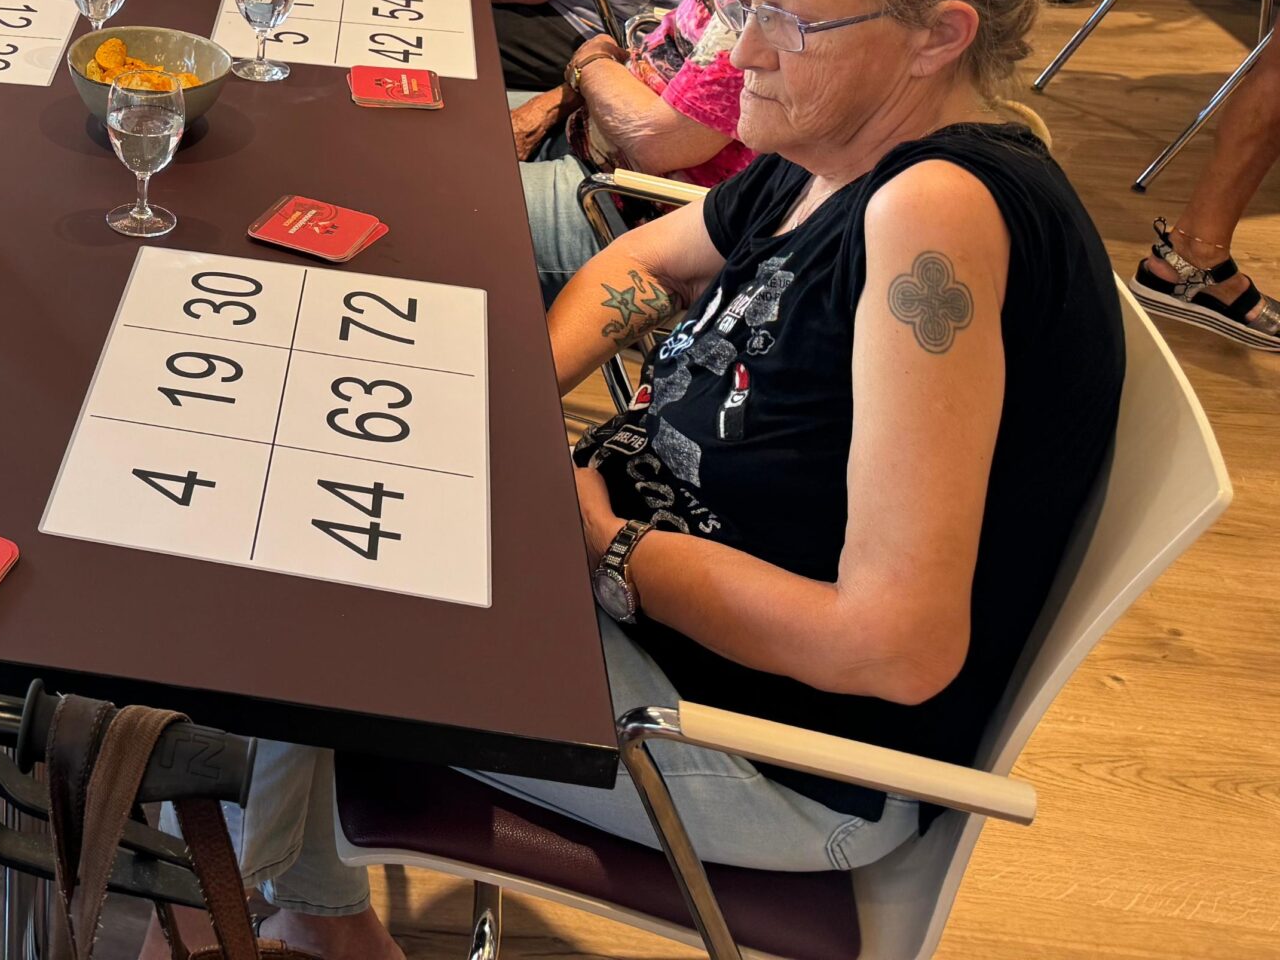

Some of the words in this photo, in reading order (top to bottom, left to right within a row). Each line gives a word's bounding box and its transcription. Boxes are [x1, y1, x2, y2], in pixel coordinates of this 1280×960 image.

[368, 32, 423, 64] 42
[182, 271, 263, 326] 30
[338, 290, 418, 346] 72
[157, 351, 244, 407] 19
[326, 376, 413, 444] 63
[132, 468, 216, 507] 4
[311, 478, 405, 561] 44
